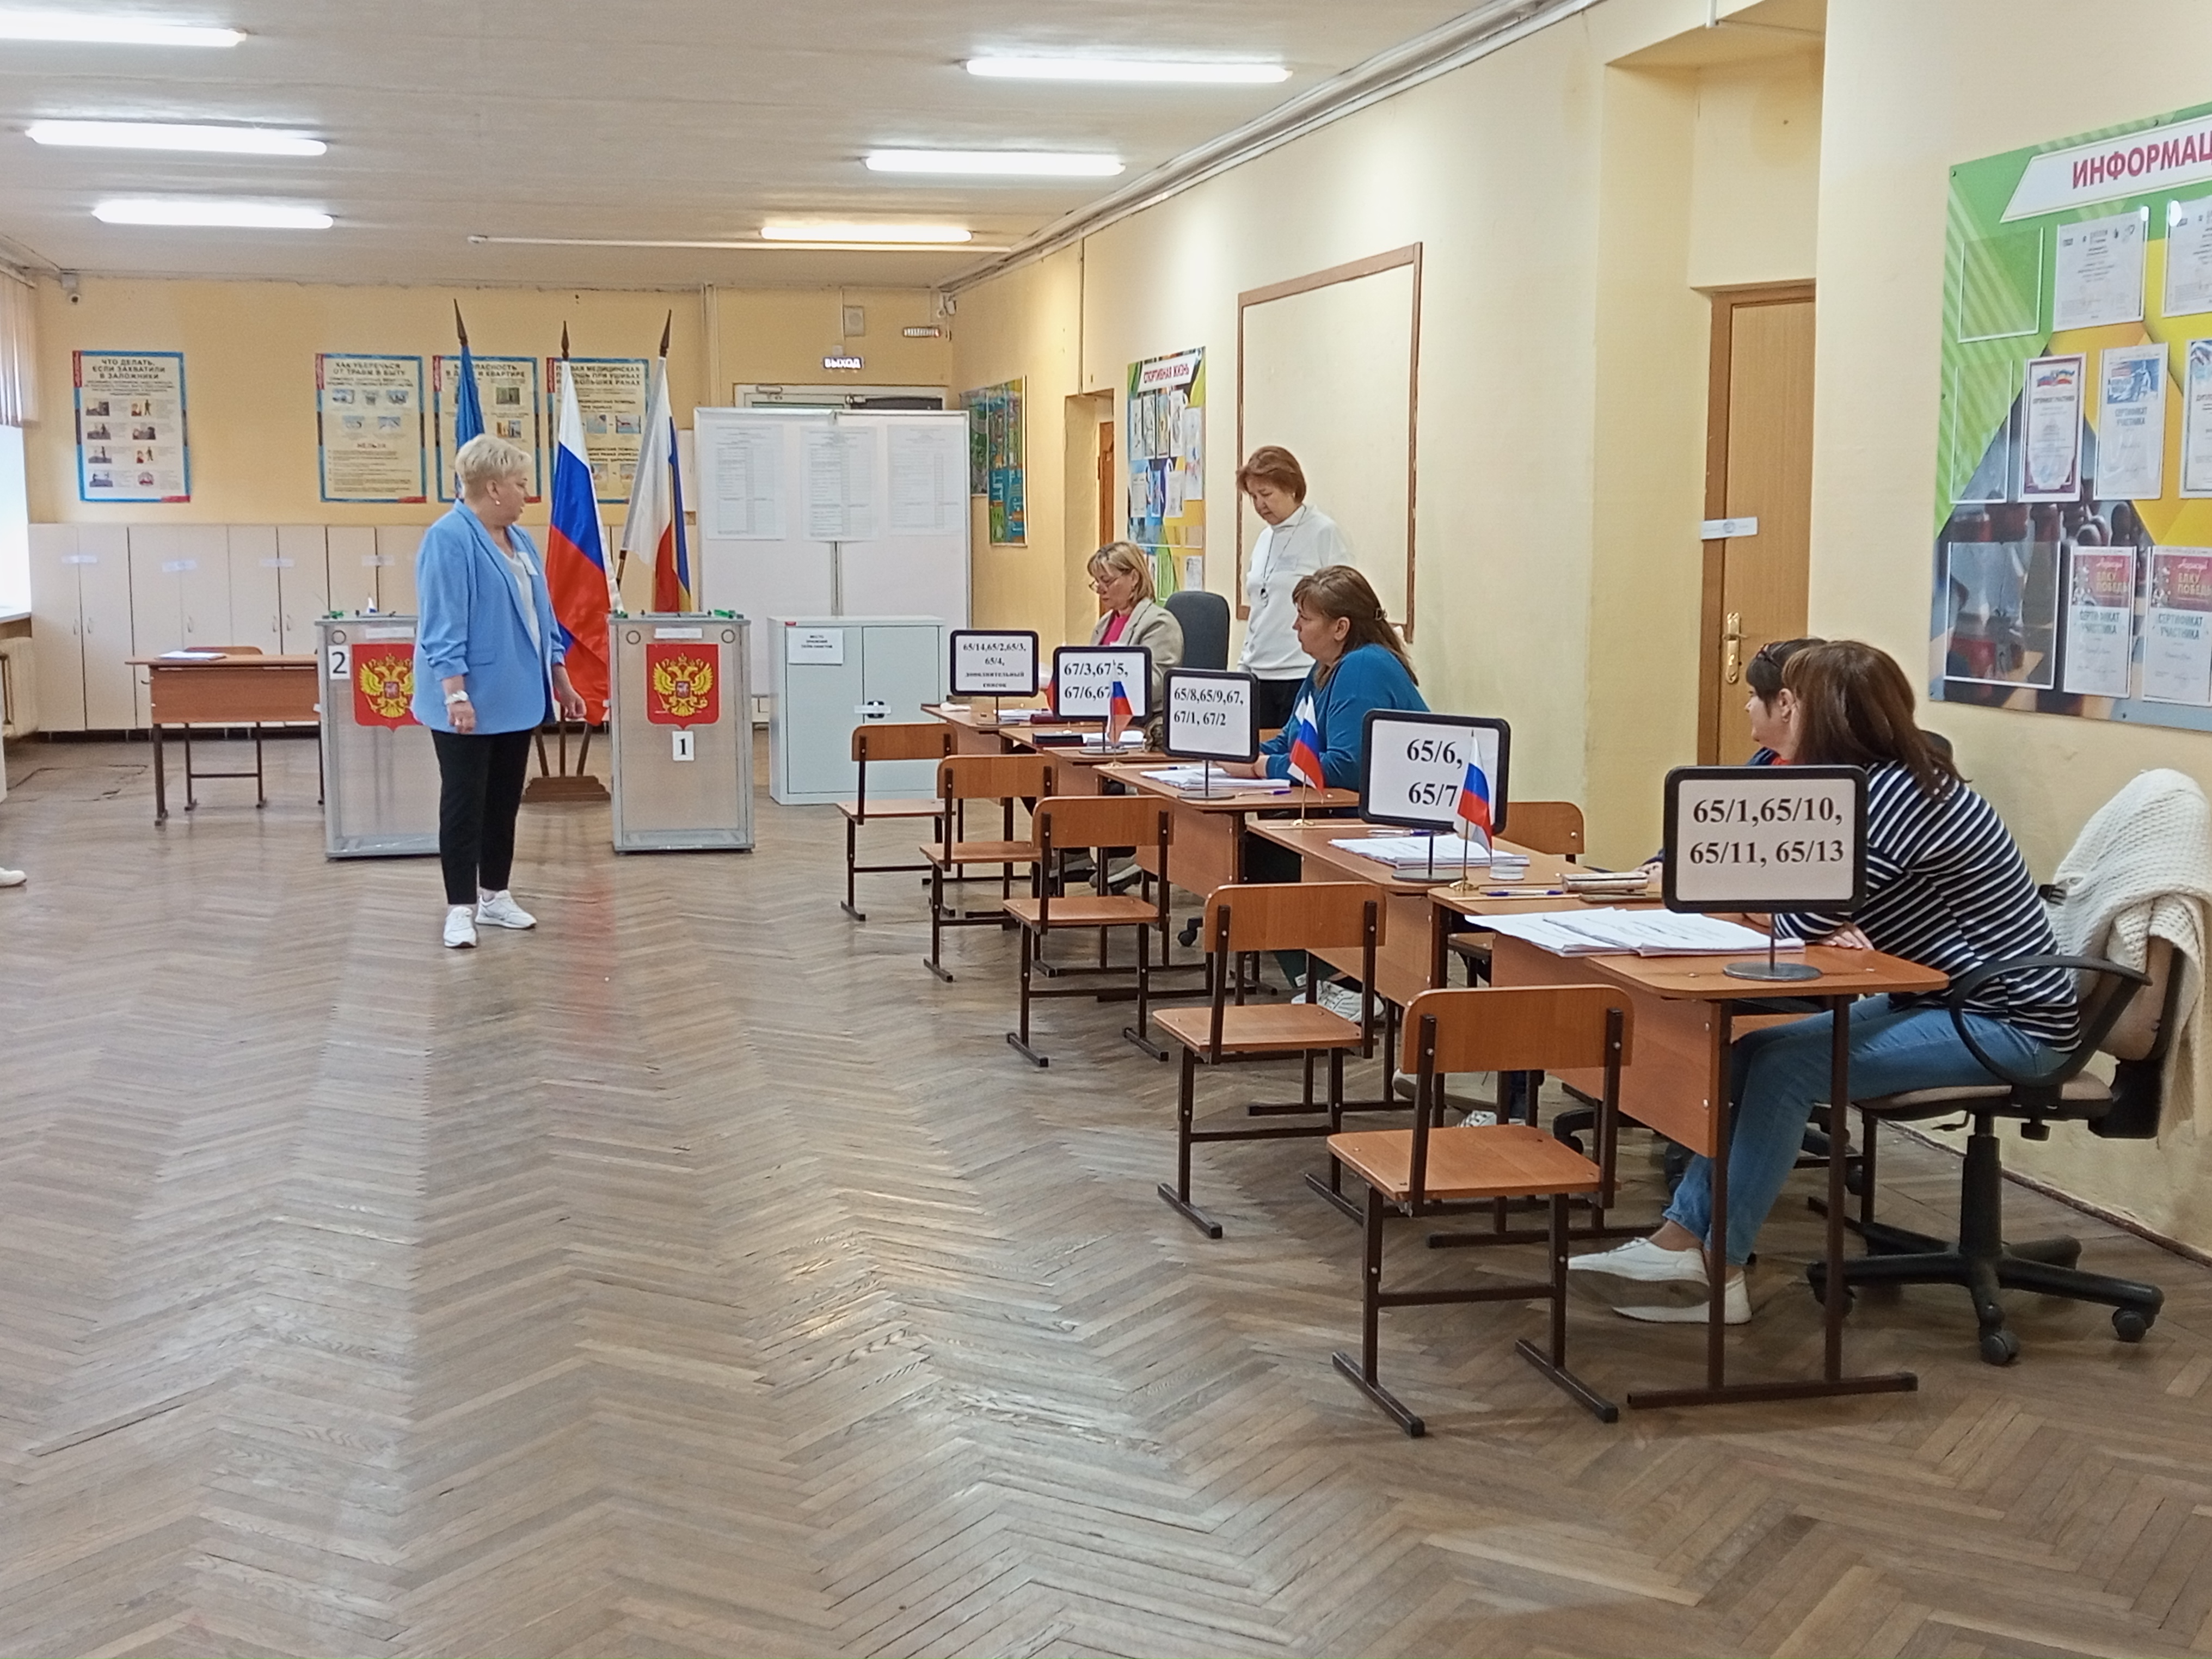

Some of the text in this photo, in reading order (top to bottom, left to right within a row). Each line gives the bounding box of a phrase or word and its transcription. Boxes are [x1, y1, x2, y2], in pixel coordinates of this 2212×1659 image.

[825, 358, 861, 369] ВЫХОД
[2158, 614, 2203, 626] СЕРТИФИКАТ
[331, 651, 347, 674] 2
[985, 657, 1005, 666] 65/4,
[1064, 662, 1128, 677] 67/3,675,
[1174, 687, 1244, 705] 65/8,65/9,67,
[1173, 710, 1227, 727] 67/1, 67/2
[679, 738, 687, 756] 1
[1406, 739, 1463, 770] 65/6,
[1408, 782, 1458, 807] 65/7
[1693, 796, 1842, 827] 65/1,65/10,
[1689, 839, 1845, 868] 65/11, 65/13
